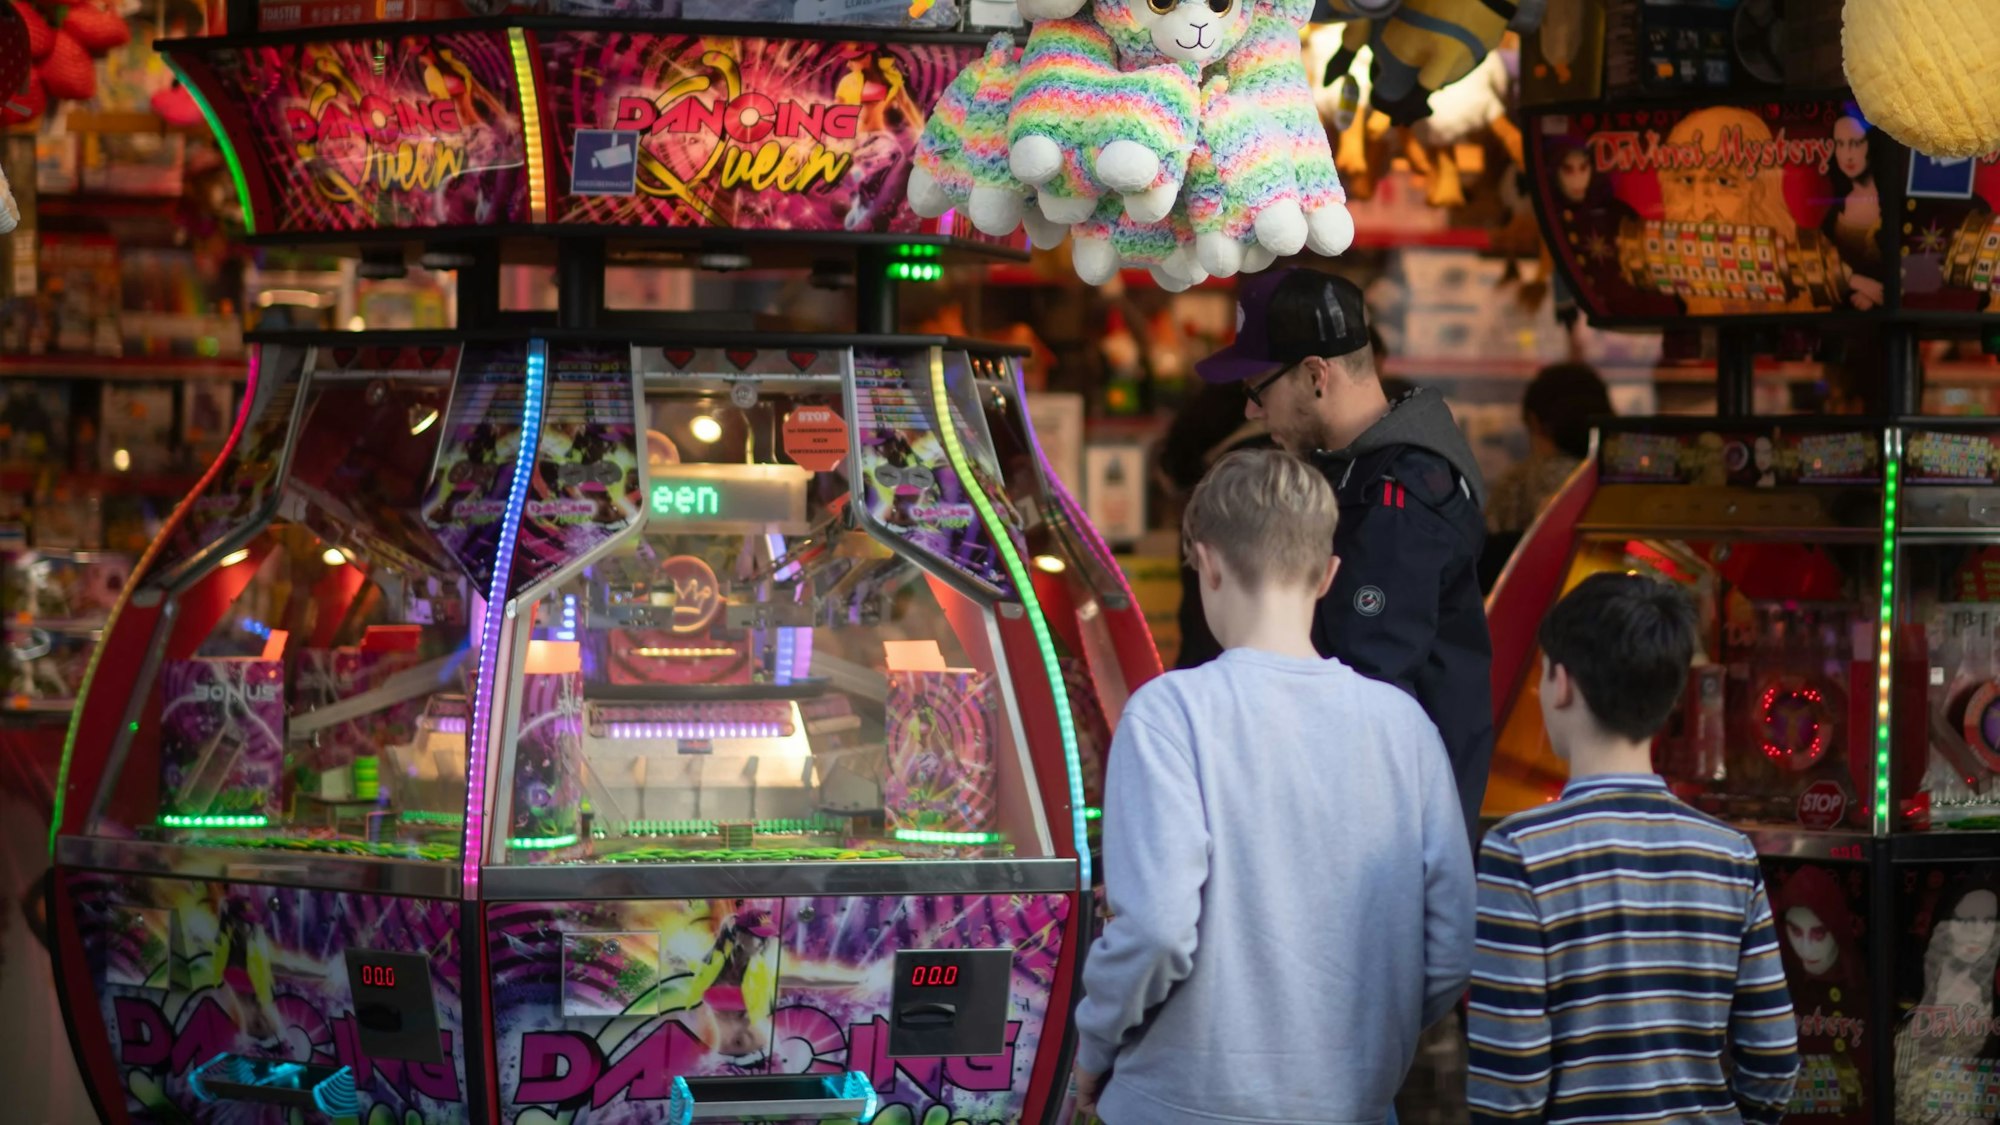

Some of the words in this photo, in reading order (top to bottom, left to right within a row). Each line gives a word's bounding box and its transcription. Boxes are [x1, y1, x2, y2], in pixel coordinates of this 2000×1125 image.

[285, 95, 462, 144] DANCING
[614, 92, 862, 143] DANCING
[798, 411, 831, 422] STOP
[652, 485, 719, 515] een
[1801, 793, 1841, 812] STOP
